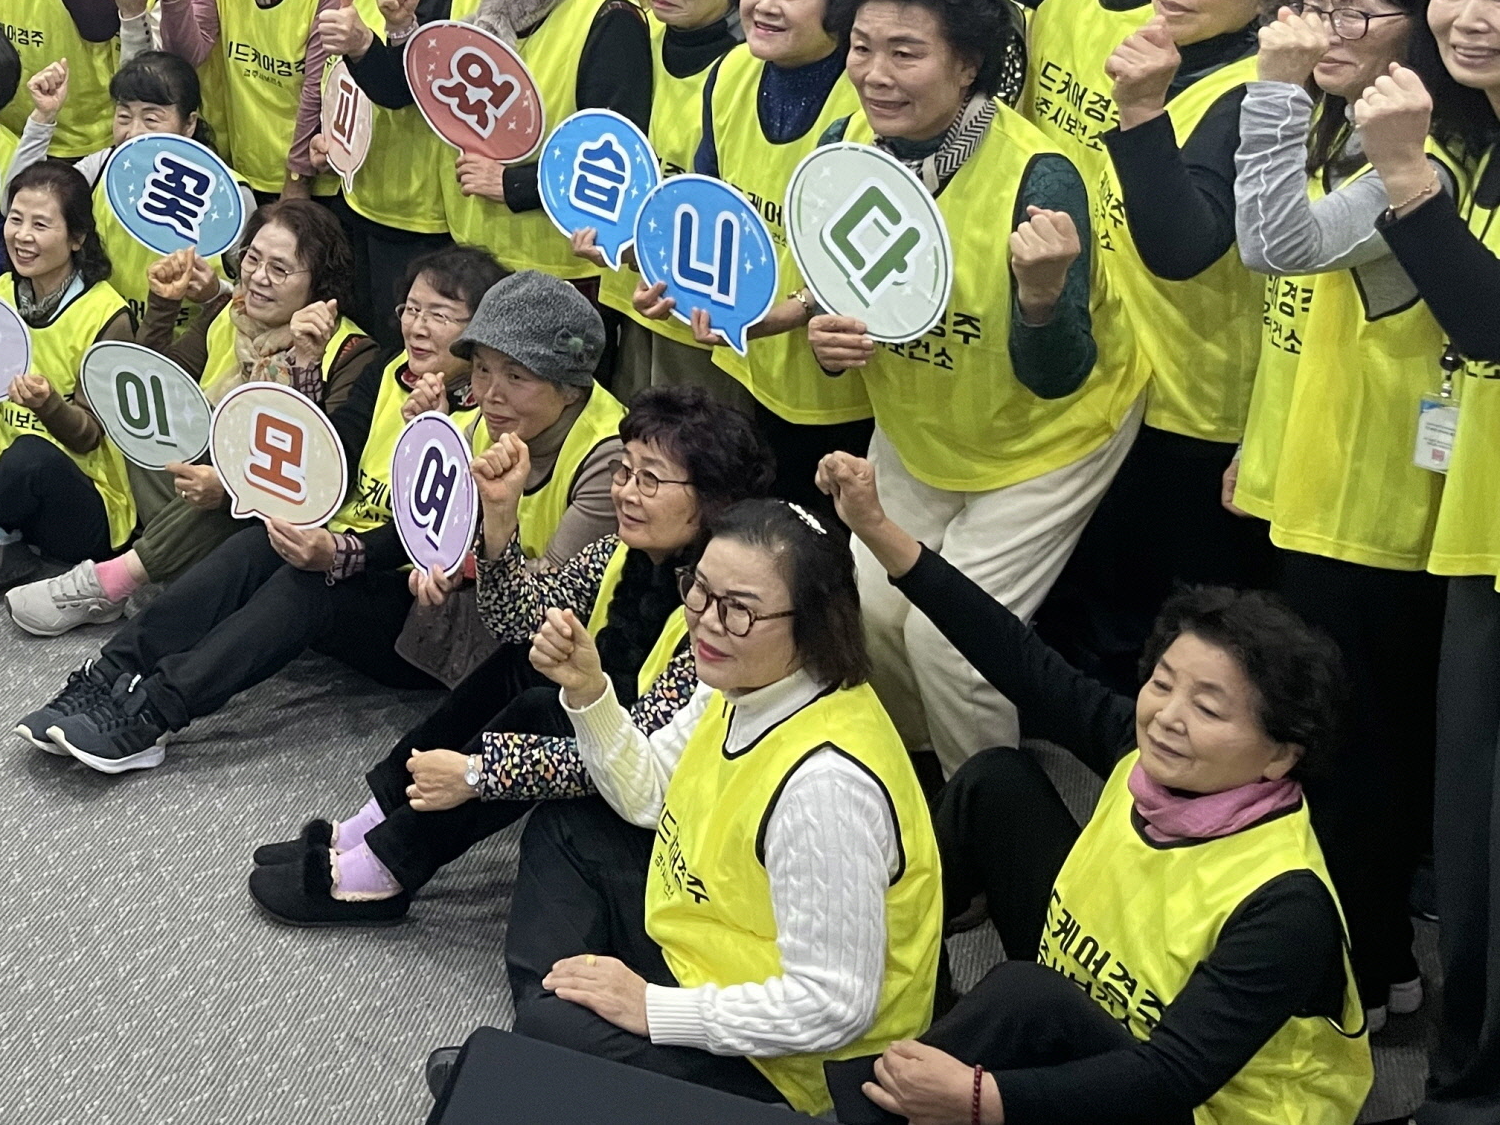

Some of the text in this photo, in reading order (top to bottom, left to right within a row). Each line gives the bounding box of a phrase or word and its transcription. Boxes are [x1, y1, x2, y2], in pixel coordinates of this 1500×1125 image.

[332, 78, 360, 147] 피
[434, 50, 517, 135] 었
[142, 153, 213, 242] 꽃
[571, 135, 628, 218] 습
[675, 207, 738, 301] 니
[827, 182, 924, 295] 다
[114, 370, 172, 440] 이
[247, 416, 308, 505] 모
[412, 445, 459, 539] 여
